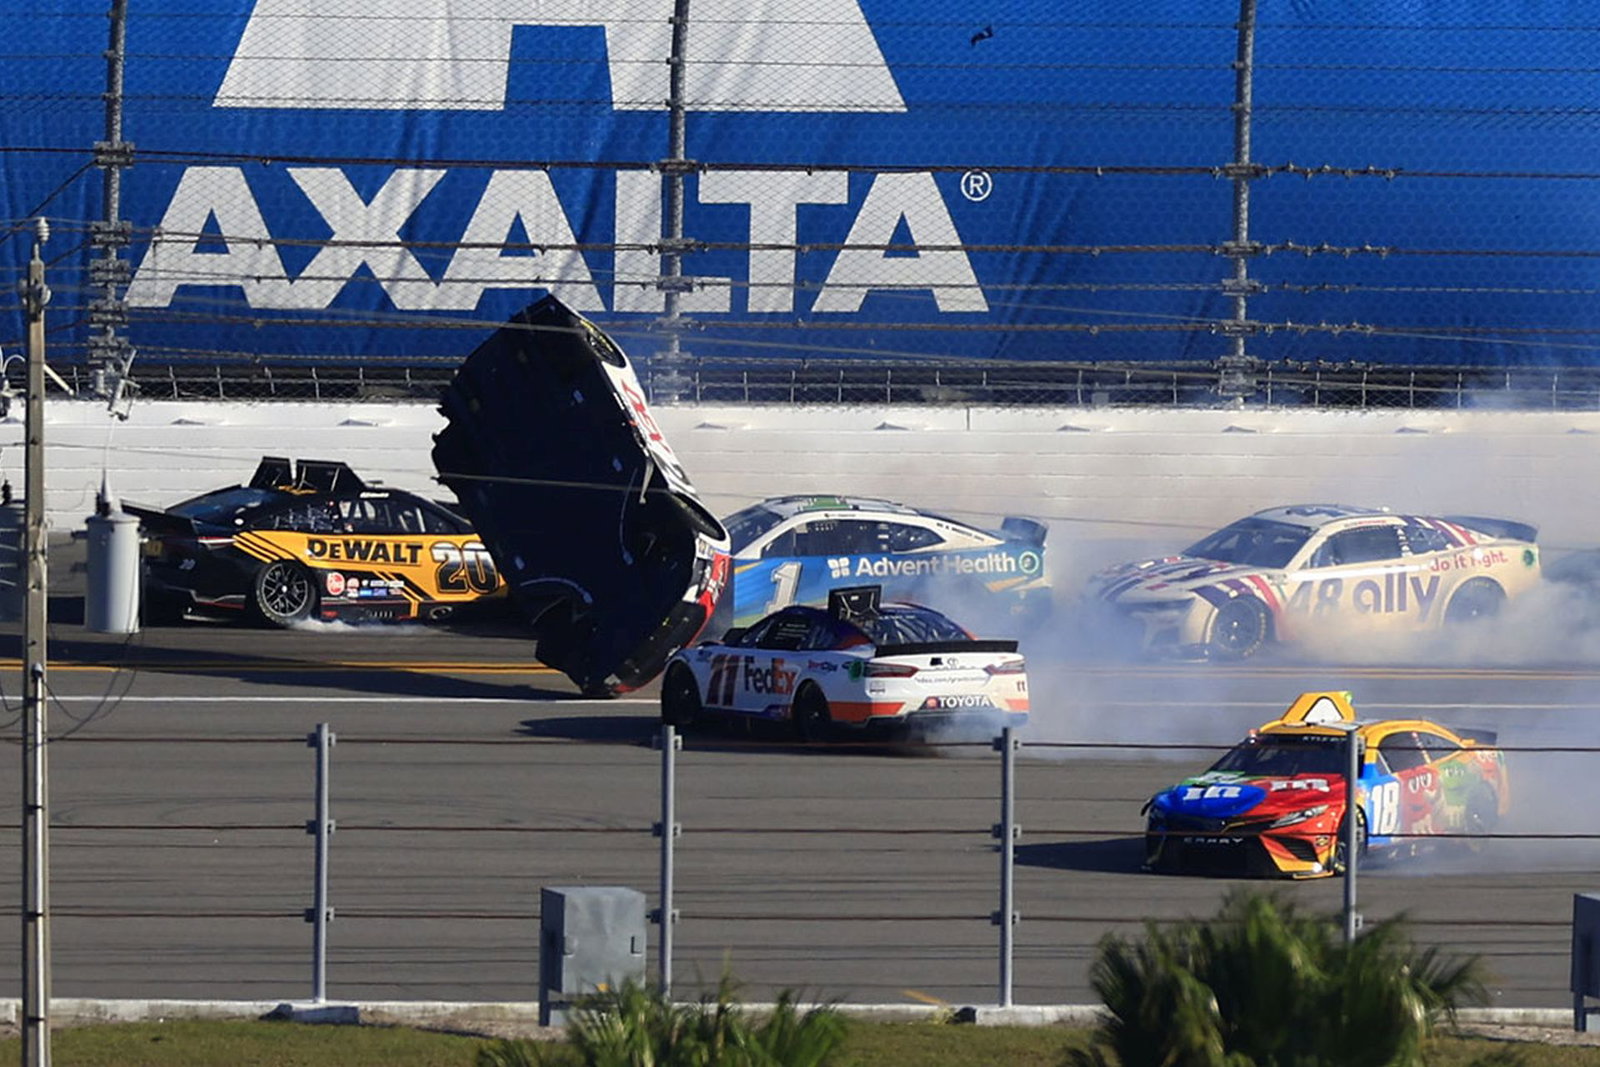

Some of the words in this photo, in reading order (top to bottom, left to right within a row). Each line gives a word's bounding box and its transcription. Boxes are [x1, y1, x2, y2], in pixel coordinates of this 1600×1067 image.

[123, 167, 991, 313] AXALTA
[430, 540, 499, 594] 20
[765, 562, 802, 616] 1
[1353, 571, 1441, 623] ally
[706, 654, 740, 706] 11
[744, 656, 797, 695] FedEx
[938, 695, 990, 708] TOYOTA
[1371, 781, 1400, 835] 18
